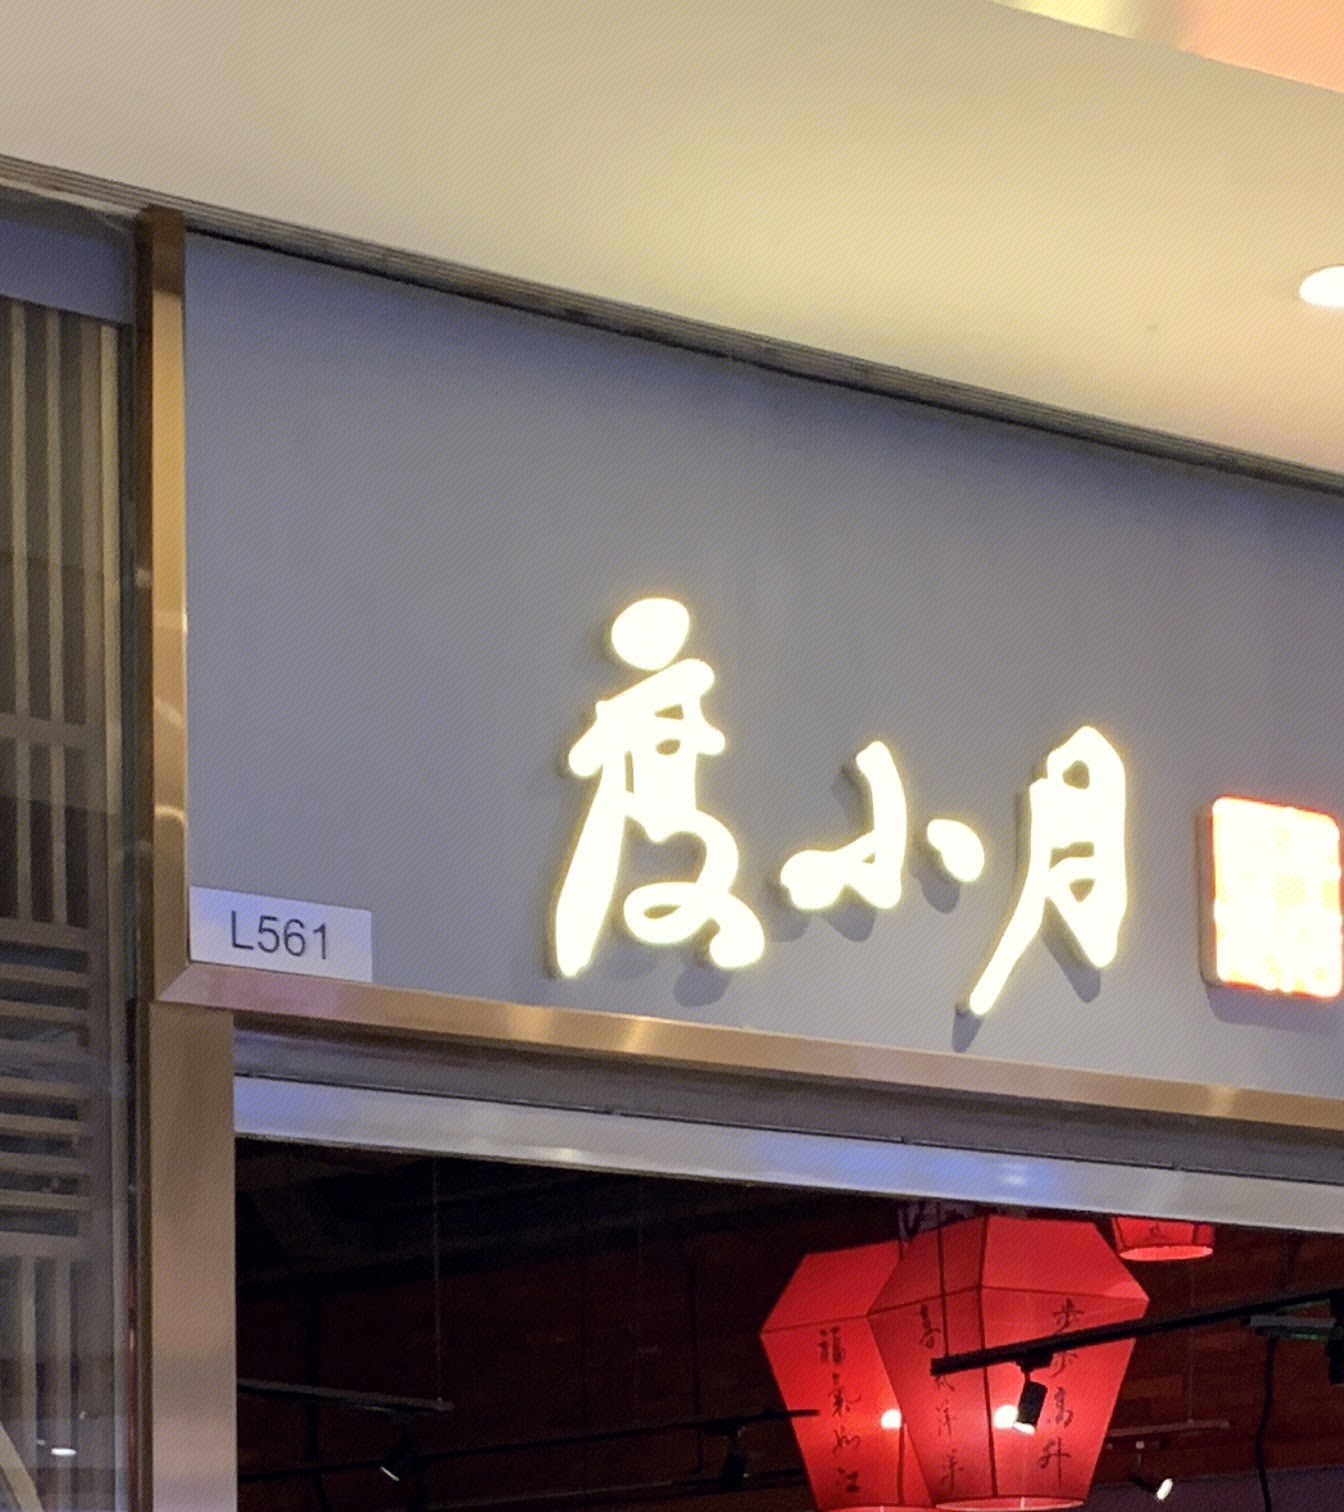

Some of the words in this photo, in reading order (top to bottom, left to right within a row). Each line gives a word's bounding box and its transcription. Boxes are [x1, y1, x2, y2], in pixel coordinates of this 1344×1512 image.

[554, 596, 1130, 1017] 度小月
[230, 909, 327, 960] L561
